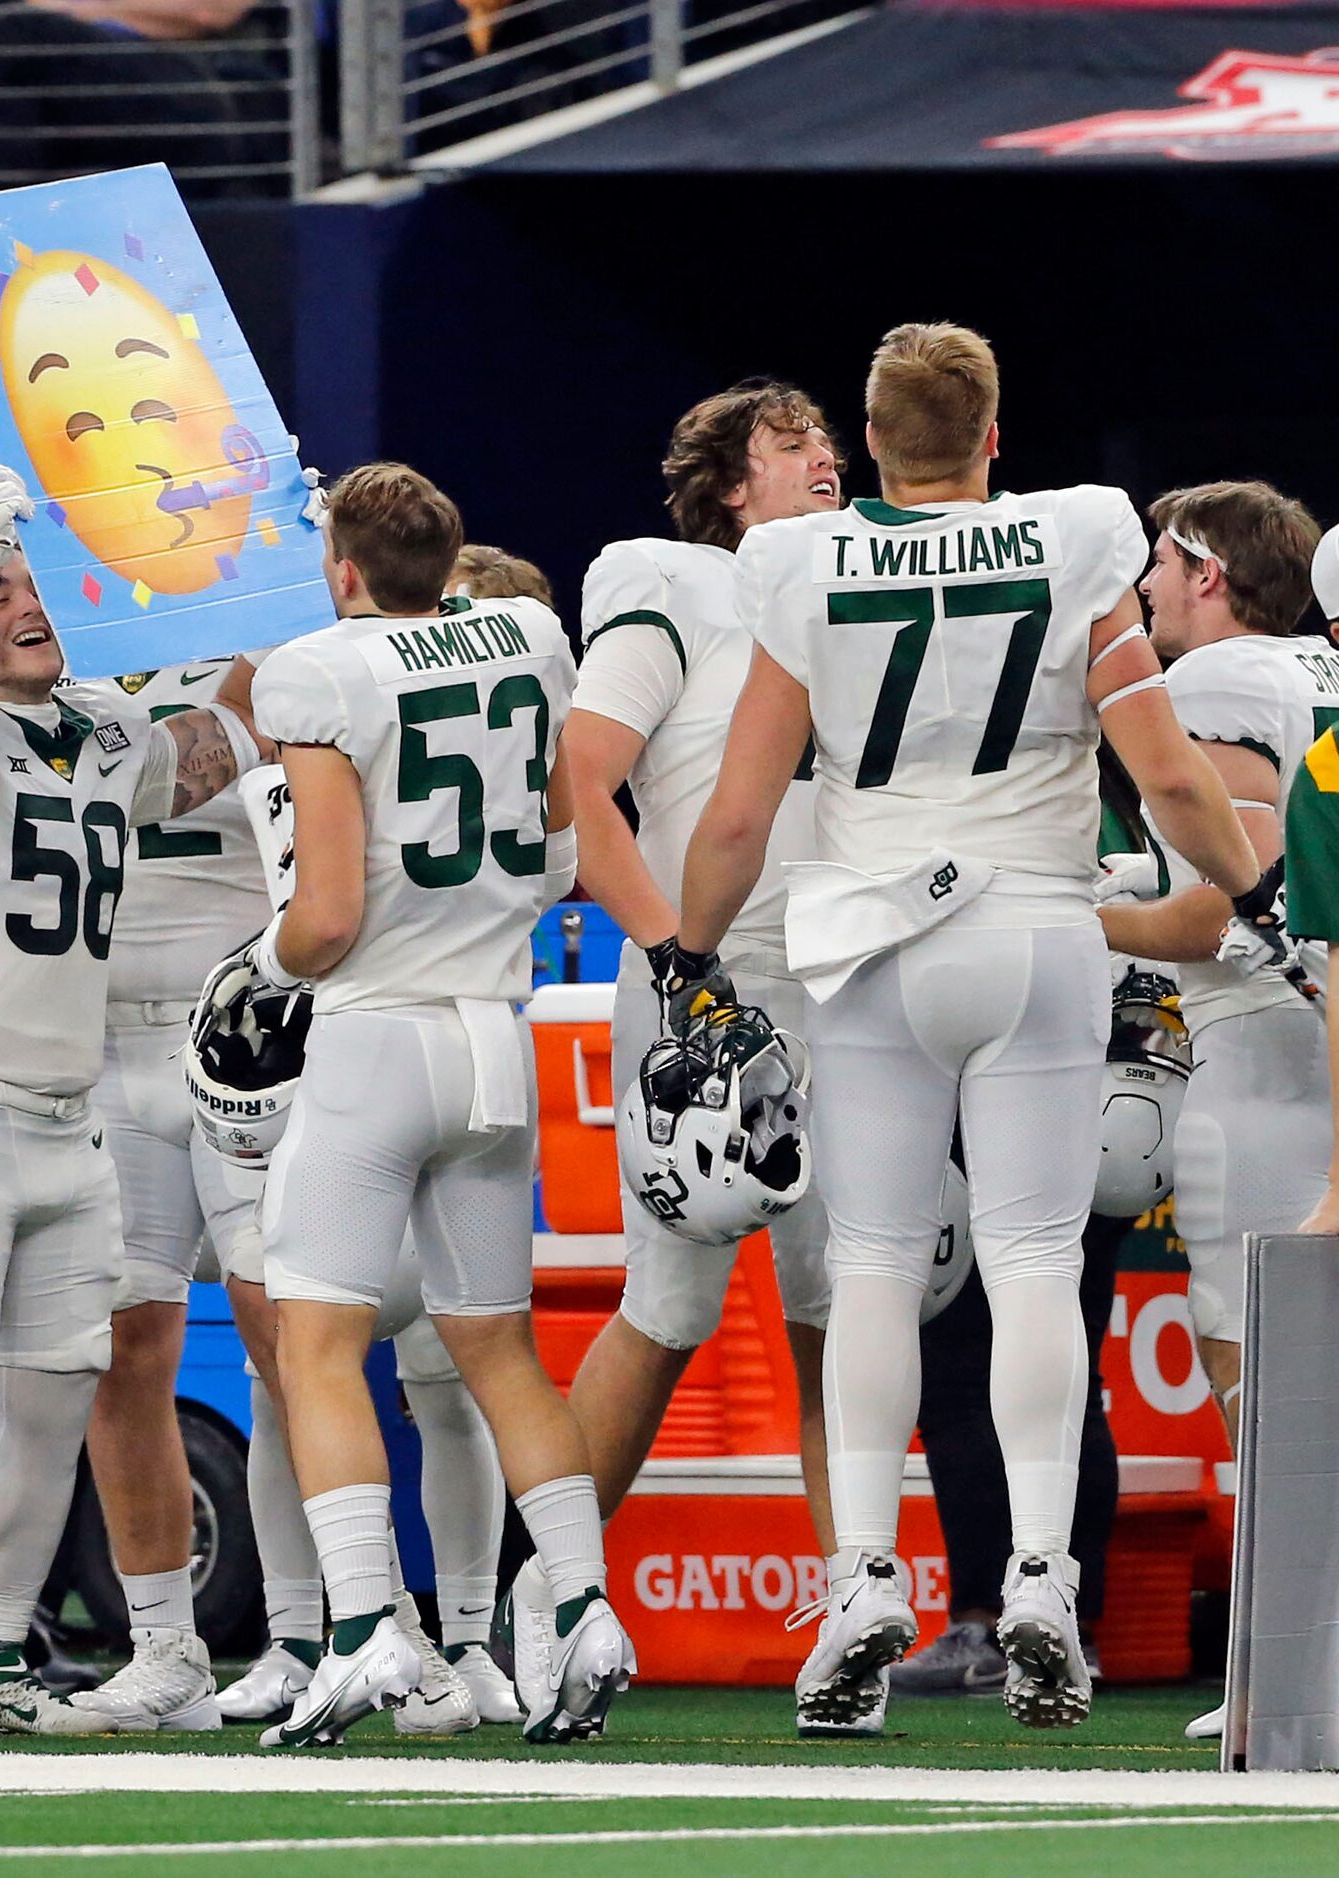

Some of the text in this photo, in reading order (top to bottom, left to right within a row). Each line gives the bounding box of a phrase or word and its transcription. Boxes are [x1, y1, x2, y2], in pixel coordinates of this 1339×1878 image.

[832, 520, 1045, 577] T. WILLIAMS
[387, 613, 530, 671] HAMILTON
[828, 578, 1052, 789] 77
[398, 674, 549, 888] 53
[5, 792, 126, 961] 58
[189, 1078, 261, 1116] Riddell
[1125, 1067, 1156, 1081] BEARS
